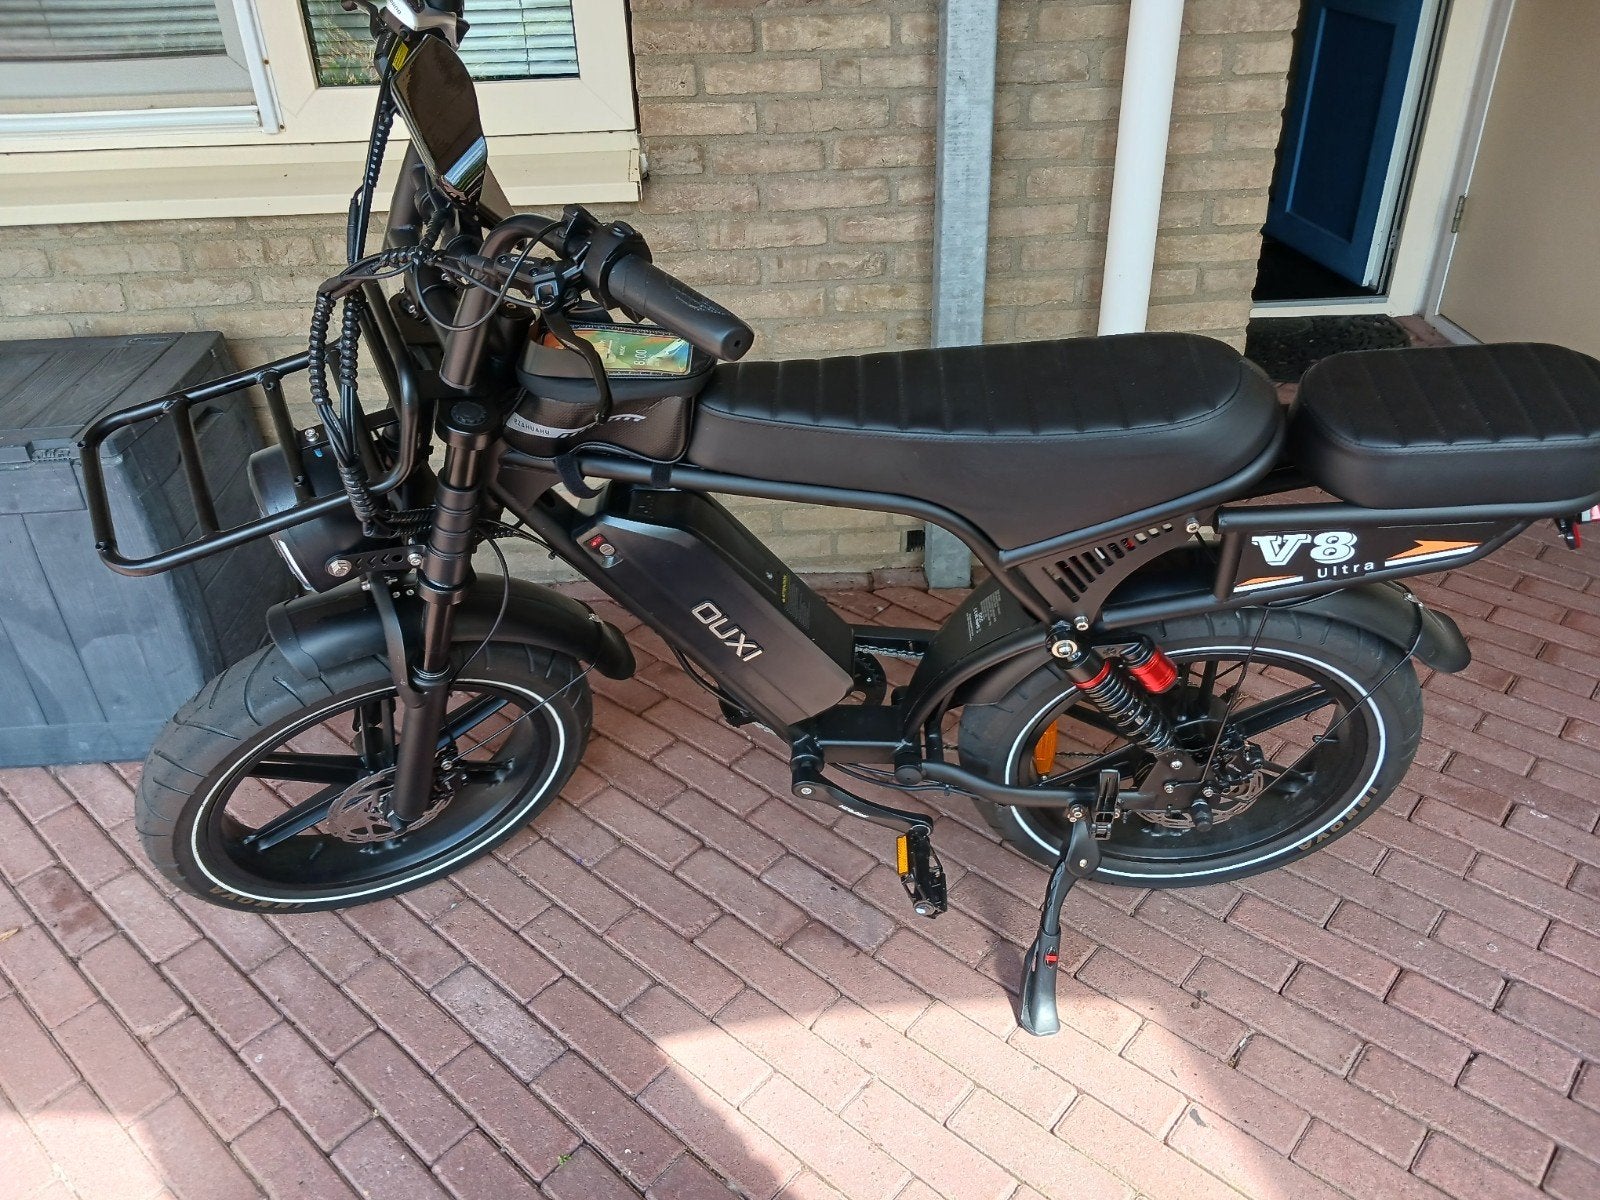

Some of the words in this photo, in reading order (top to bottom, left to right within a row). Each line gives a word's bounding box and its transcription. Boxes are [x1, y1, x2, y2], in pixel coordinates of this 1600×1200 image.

[633, 349, 648, 366] 8:00
[1251, 531, 1358, 566] V8
[1317, 561, 1375, 579] Ultra
[691, 602, 763, 662] OUXI
[1298, 787, 1378, 851] INNOVA
